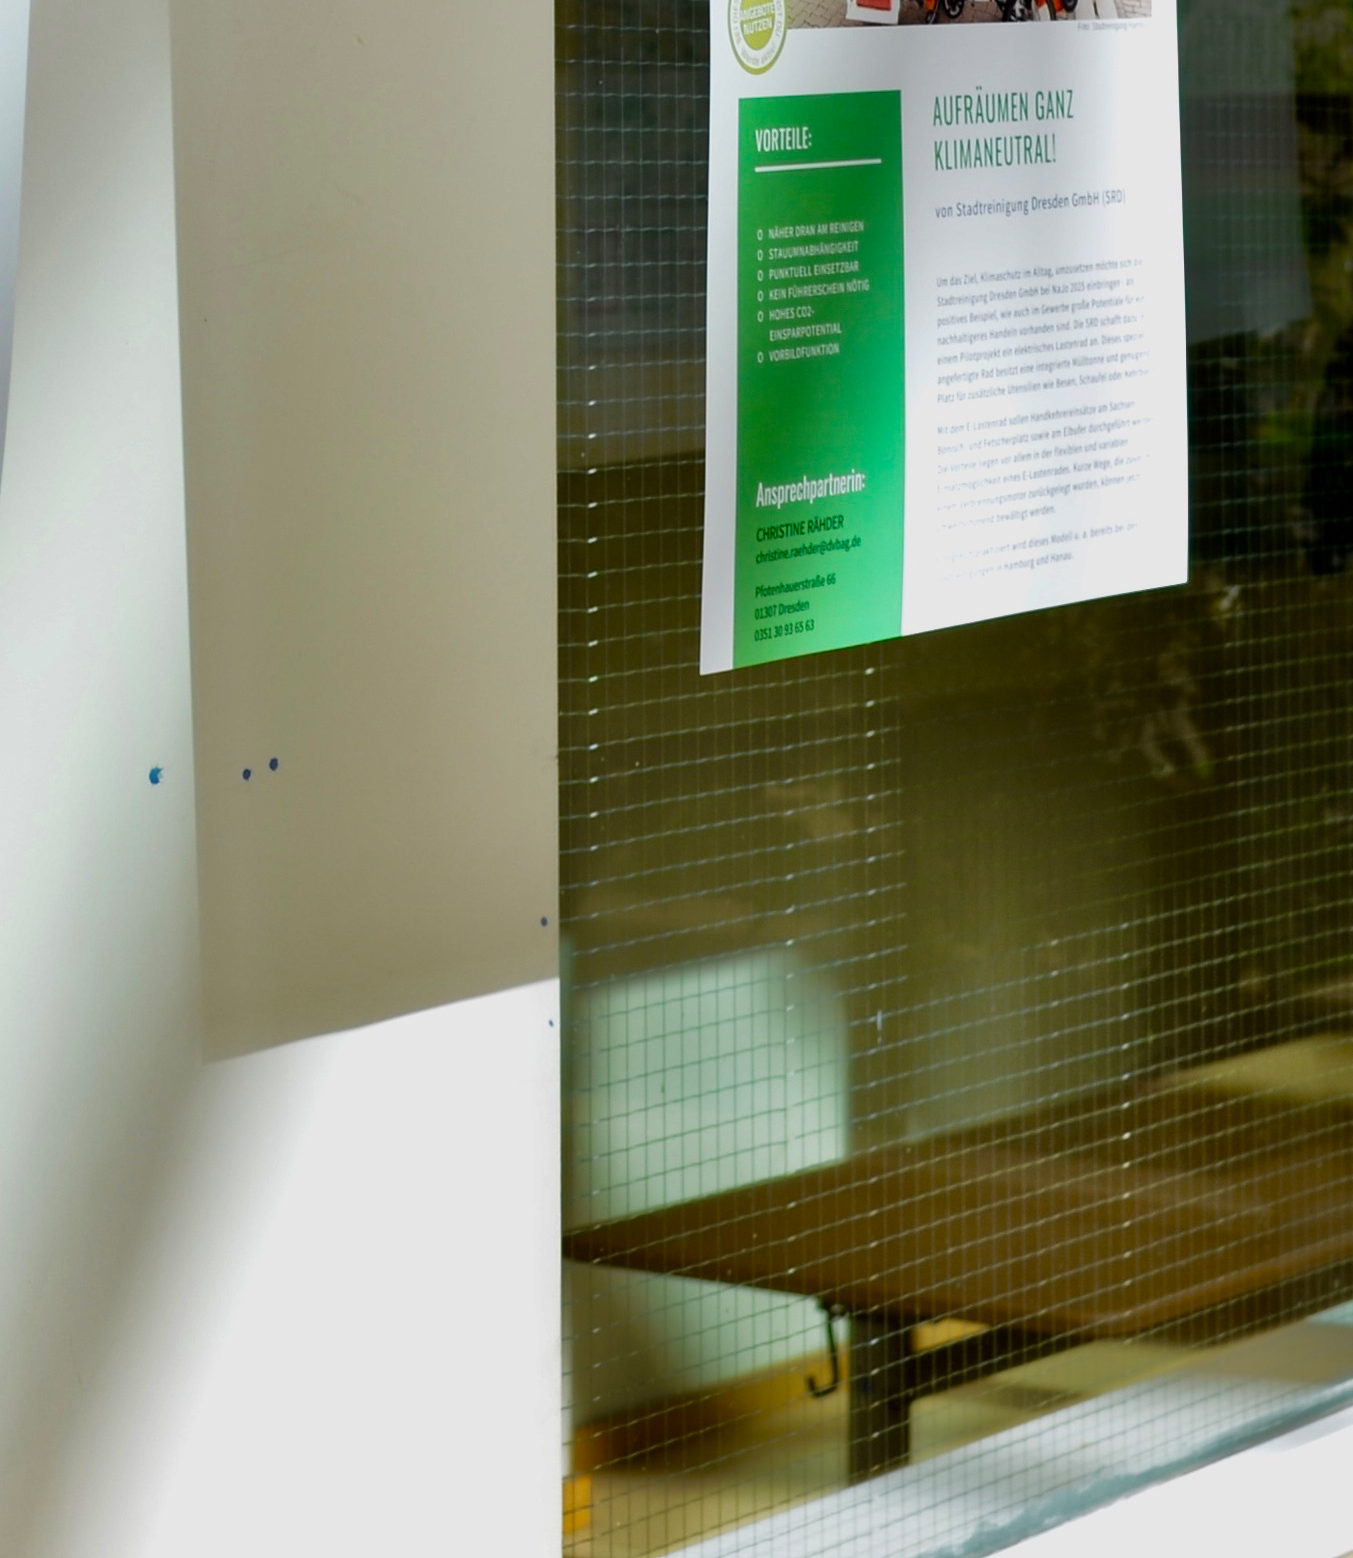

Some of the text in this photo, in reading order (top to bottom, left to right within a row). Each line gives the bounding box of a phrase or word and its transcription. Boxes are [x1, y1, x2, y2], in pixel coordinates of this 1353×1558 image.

[743, 16, 772, 35] NUTZEN
[933, 86, 1073, 127] AUFRÄUMEN GANZ
[755, 126, 812, 152] VORTEILE:
[934, 134, 1056, 171] KLIMANEUTRAL!
[936, 189, 1125, 218] von Stadtreinigung Dresden GmbH (SRD)
[769, 221, 864, 239] NÄHER DRAN AM REINIGEN
[769, 261, 859, 280] PUNKTUELL EINSETZBAR
[769, 279, 870, 300] KEIN FÜHRERSCHEIN NÖTIG
[769, 306, 814, 320] HOHES CO2-
[770, 322, 842, 341] EINSPARPOTENTIAL
[769, 343, 840, 362] VORBILDFUNKTION
[756, 469, 865, 509] Ansprechpartnerin:
[756, 515, 844, 542] CHRISTINE RÄHDER
[755, 573, 835, 598] Pfotenhauerstraße 66
[755, 601, 809, 620] 01307 Dresden
[755, 628, 771, 641] 0351
[774, 625, 783, 638] 30
[785, 623, 793, 635] 93
[805, 619, 814, 631] 63
